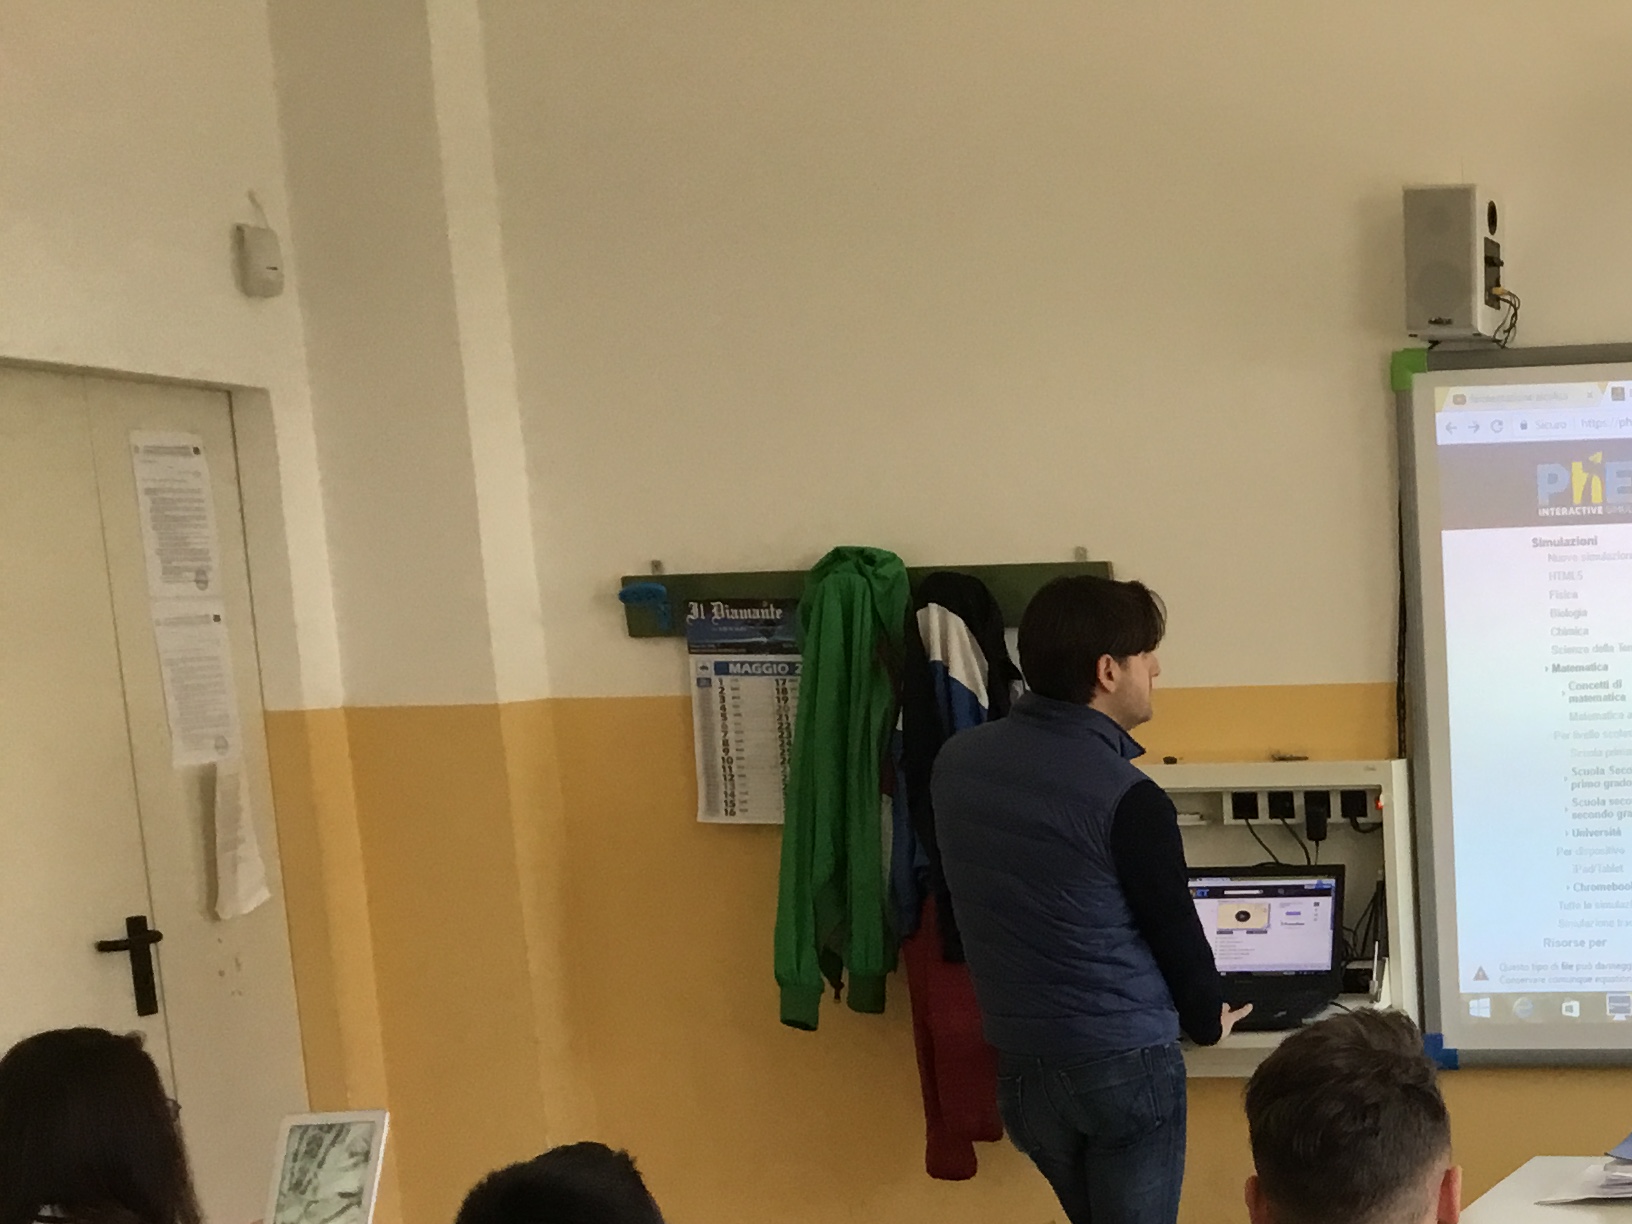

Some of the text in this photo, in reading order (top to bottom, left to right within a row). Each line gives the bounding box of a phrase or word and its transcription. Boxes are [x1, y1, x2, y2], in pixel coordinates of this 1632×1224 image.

[1538, 506, 1603, 517] INTERACTIVE
[1531, 536, 1598, 549] Simulazioni
[1548, 570, 1584, 581] HTML5
[1549, 589, 1578, 600] Fisica
[710, 600, 784, 626] Diamante
[1550, 607, 1588, 620] Biologia
[1550, 625, 1589, 637] Chimica
[729, 662, 789, 675] MAGGIO
[1552, 662, 1609, 674] Matematica
[775, 678, 786, 686] 17
[1568, 678, 1623, 692] Concetti di
[776, 687, 788, 695] 18
[776, 696, 789, 704] 19
[1568, 692, 1627, 703] matematica
[722, 756, 733, 765] 10
[1571, 766, 1606, 777] Scuola
[1571, 778, 1632, 791] primo grado
[1571, 797, 1606, 808] Scuola
[1571, 809, 1615, 820] secondo
[1572, 827, 1622, 838] Università
[1543, 937, 1608, 950] Risorse per
